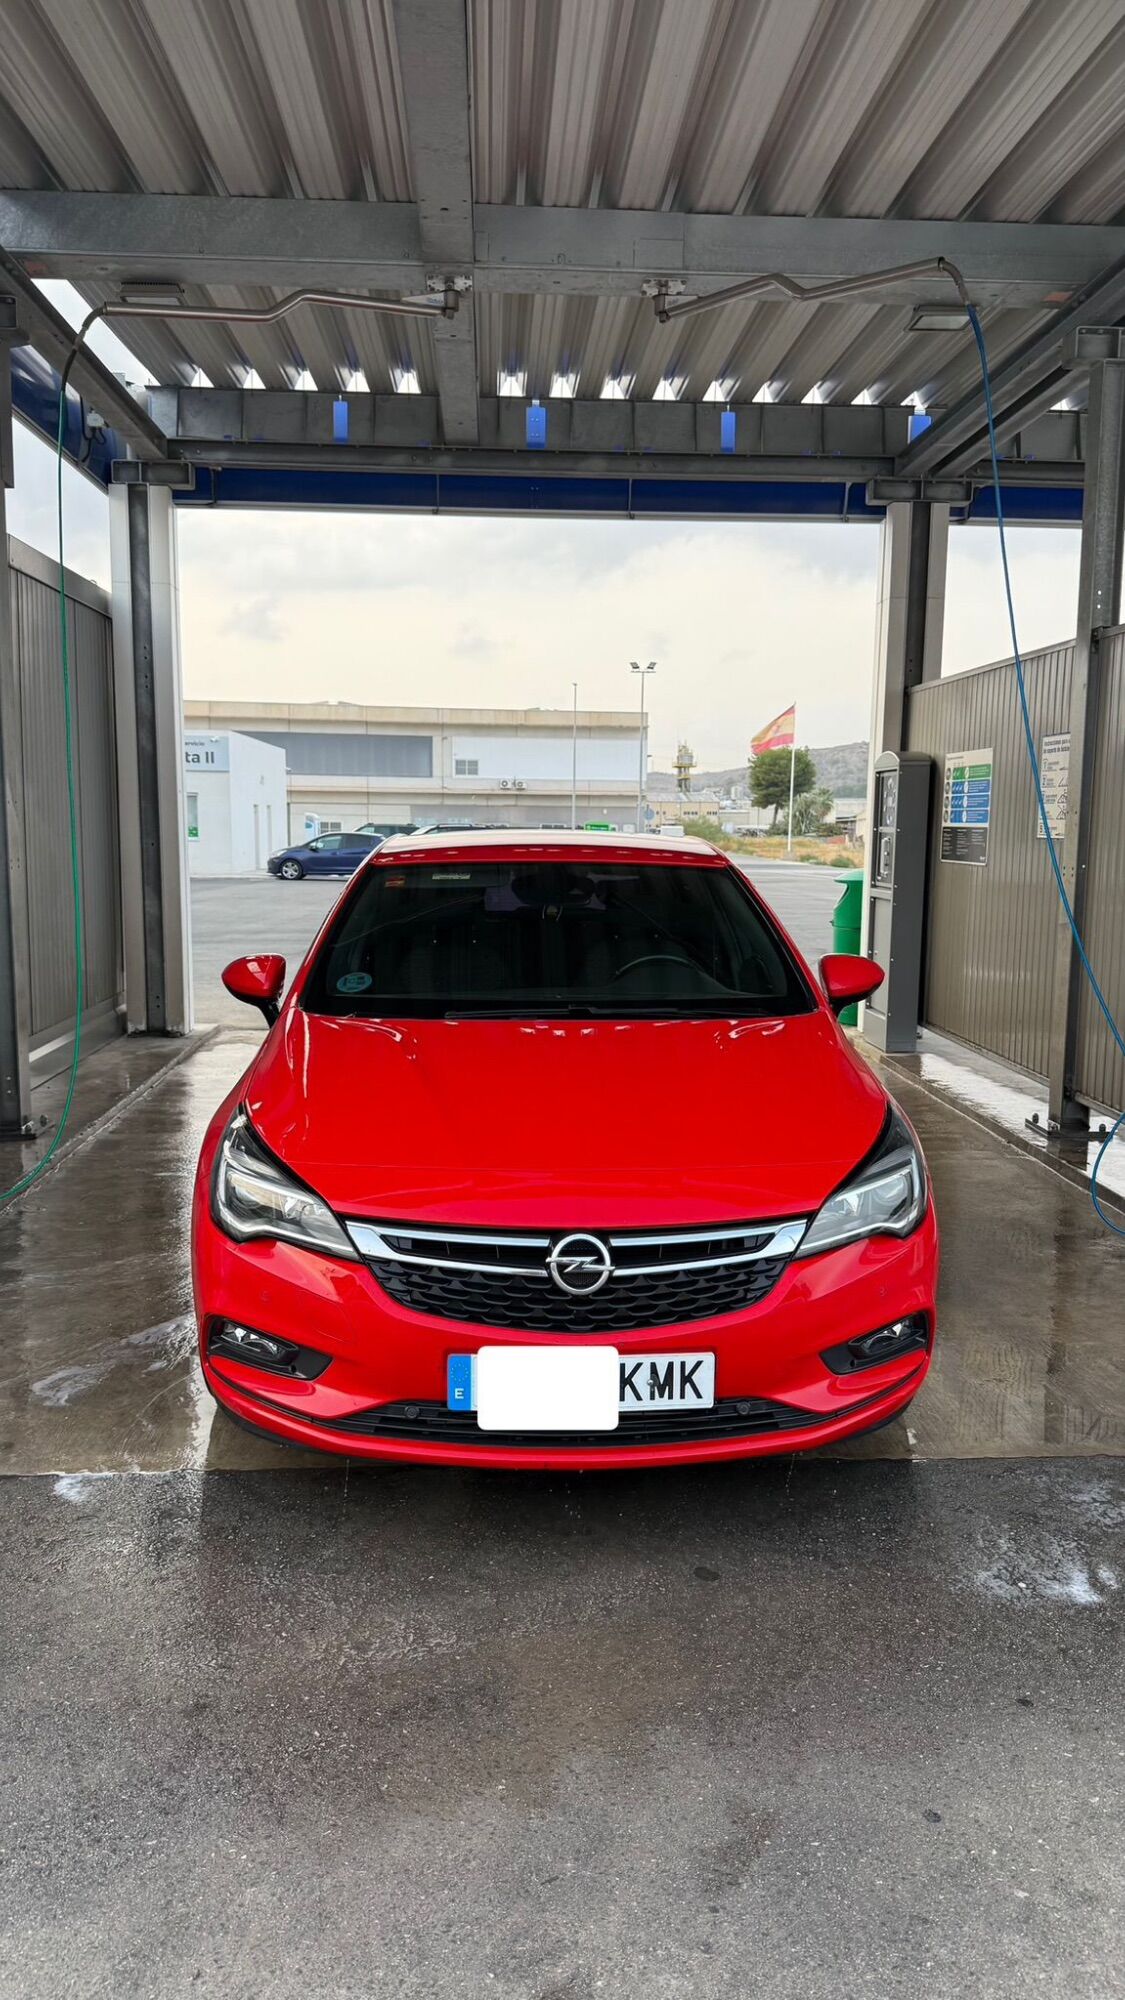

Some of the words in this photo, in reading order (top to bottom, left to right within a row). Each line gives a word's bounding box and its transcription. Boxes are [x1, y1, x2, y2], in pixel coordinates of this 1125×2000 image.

[185, 752, 200, 763] ta
[619, 1360, 705, 1402] KMK
[454, 1388, 465, 1400] E
